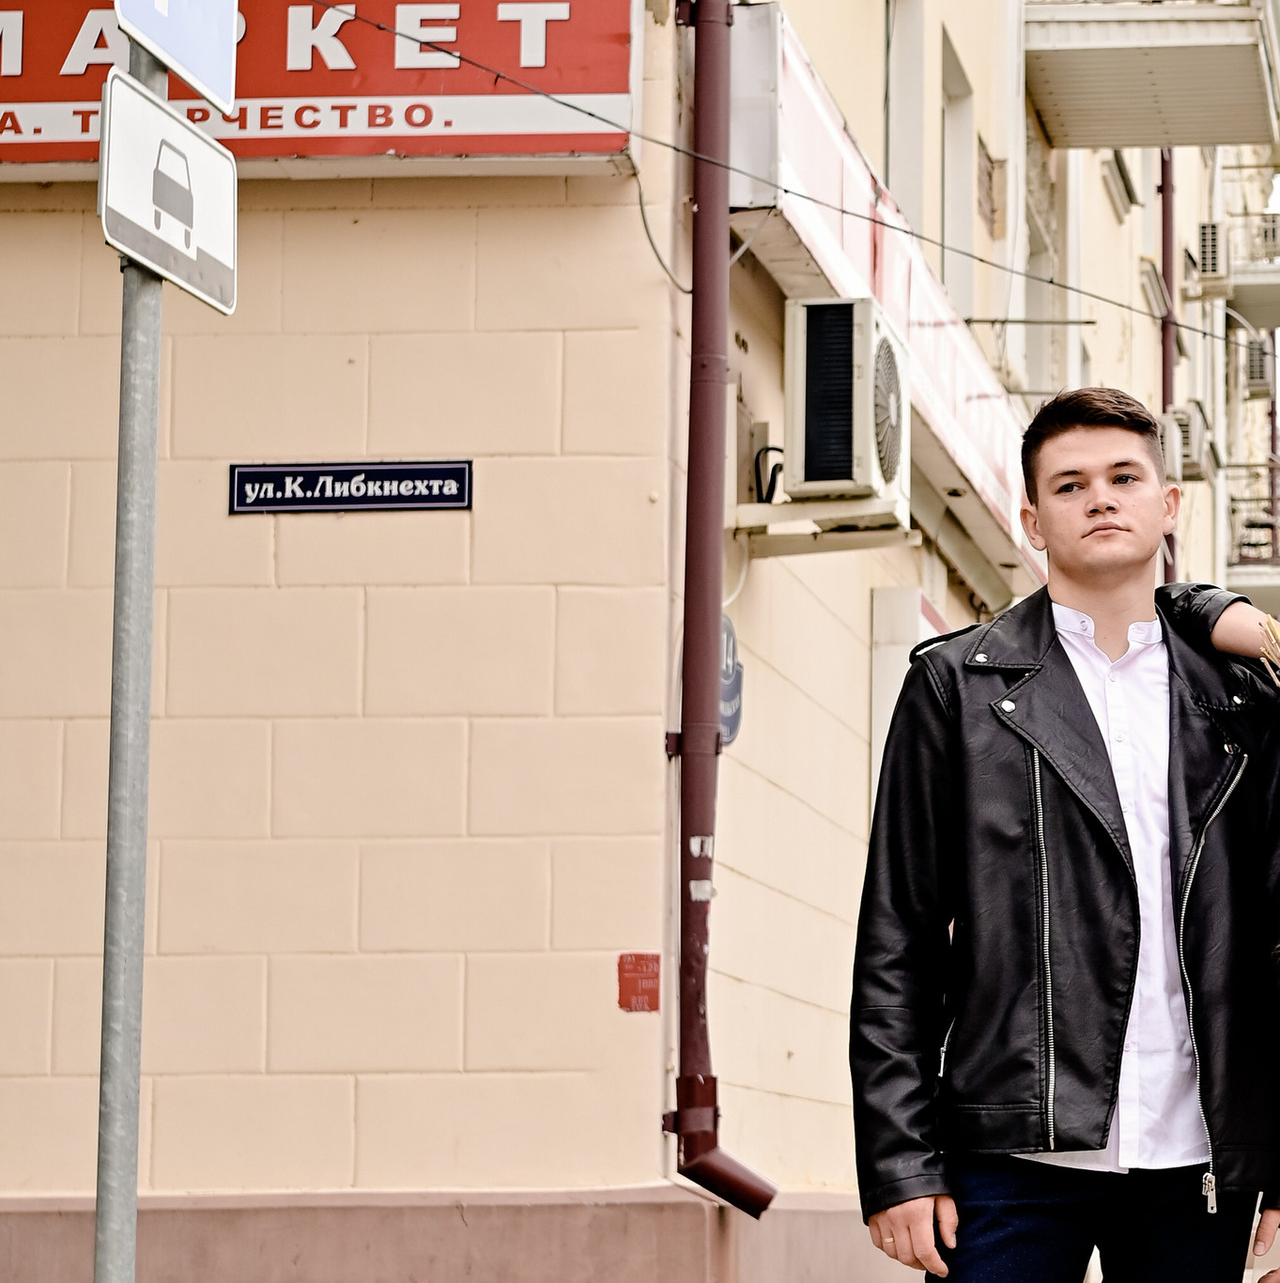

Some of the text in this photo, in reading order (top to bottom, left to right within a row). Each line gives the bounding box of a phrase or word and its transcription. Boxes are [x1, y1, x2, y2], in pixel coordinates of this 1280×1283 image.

[0, 2, 570, 76] АКЕТ
[72, 103, 453, 134] ТРЧЕСТВО.
[244, 473, 459, 504] ул.К.Либкнехта
